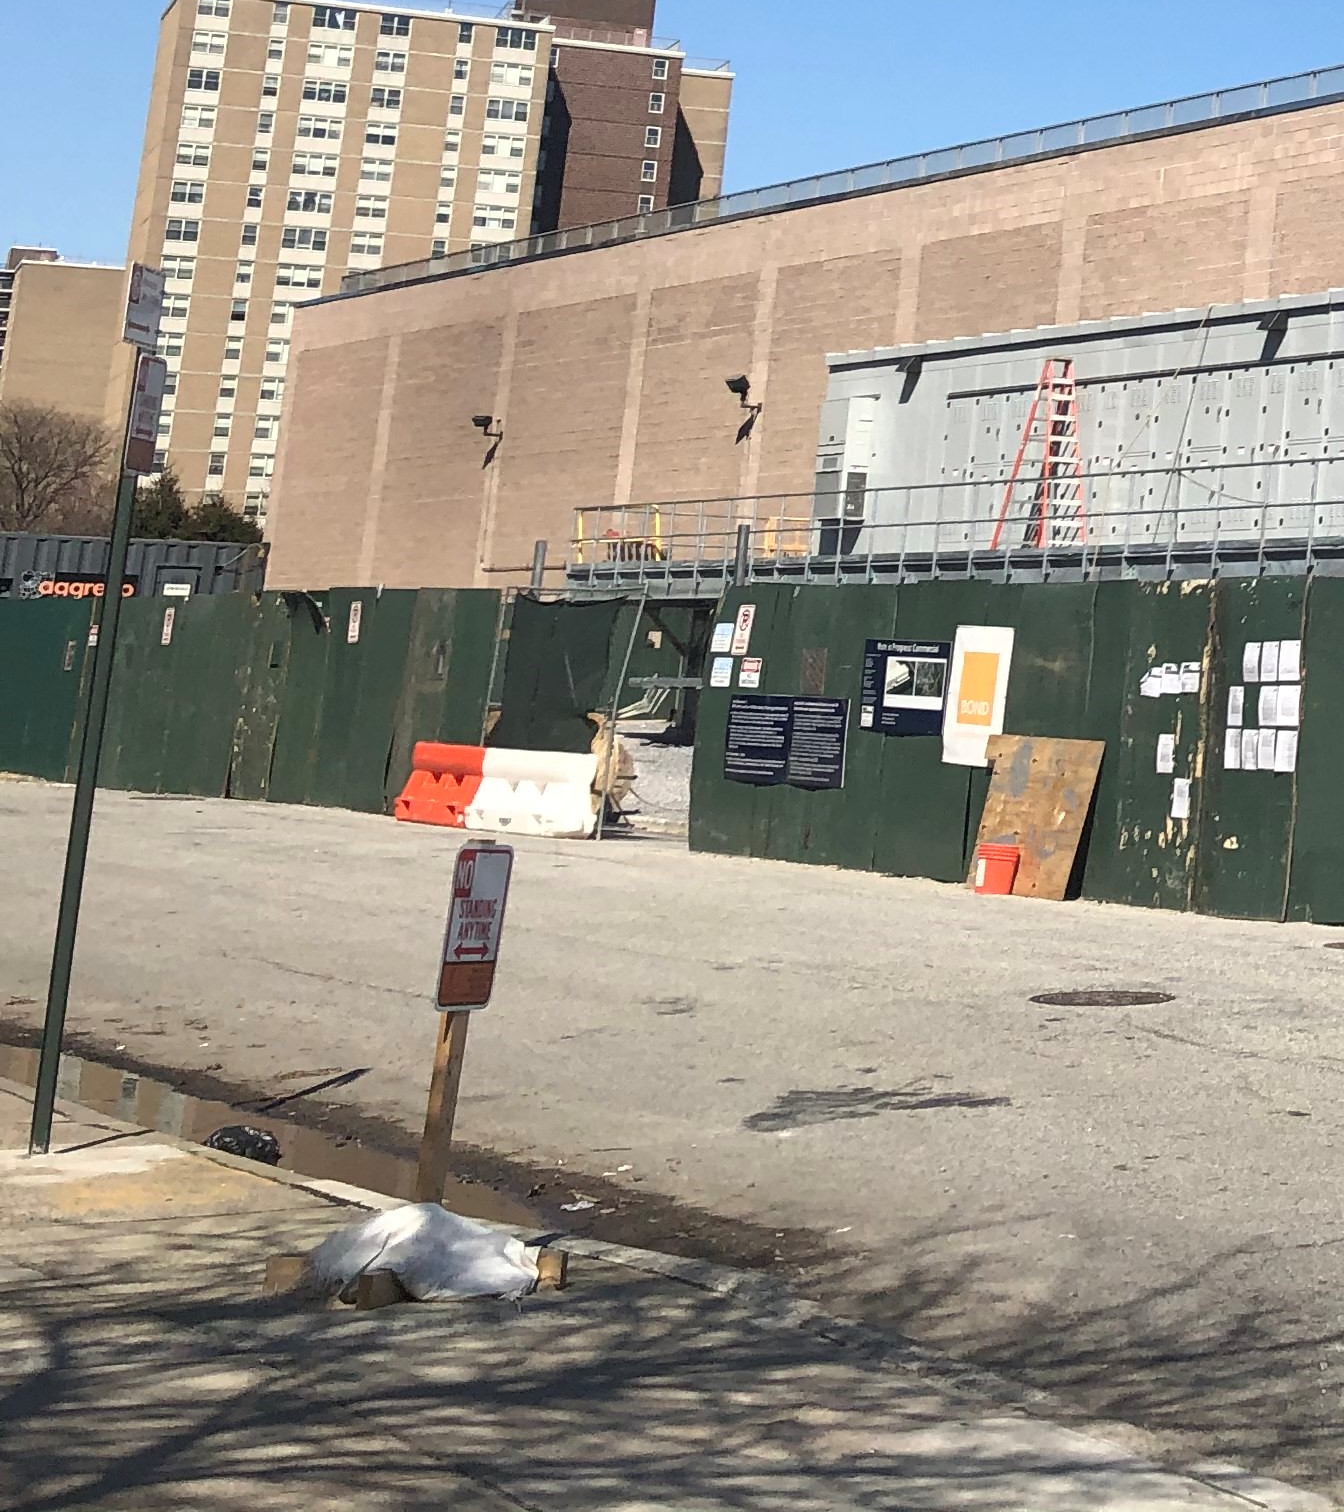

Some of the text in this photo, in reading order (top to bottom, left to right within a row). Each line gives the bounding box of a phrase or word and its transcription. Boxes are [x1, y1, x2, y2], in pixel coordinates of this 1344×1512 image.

[38, 580, 135, 599] aggreo
[960, 699, 990, 716] BOND
[456, 860, 473, 889] NO
[459, 899, 497, 919] STANDING
